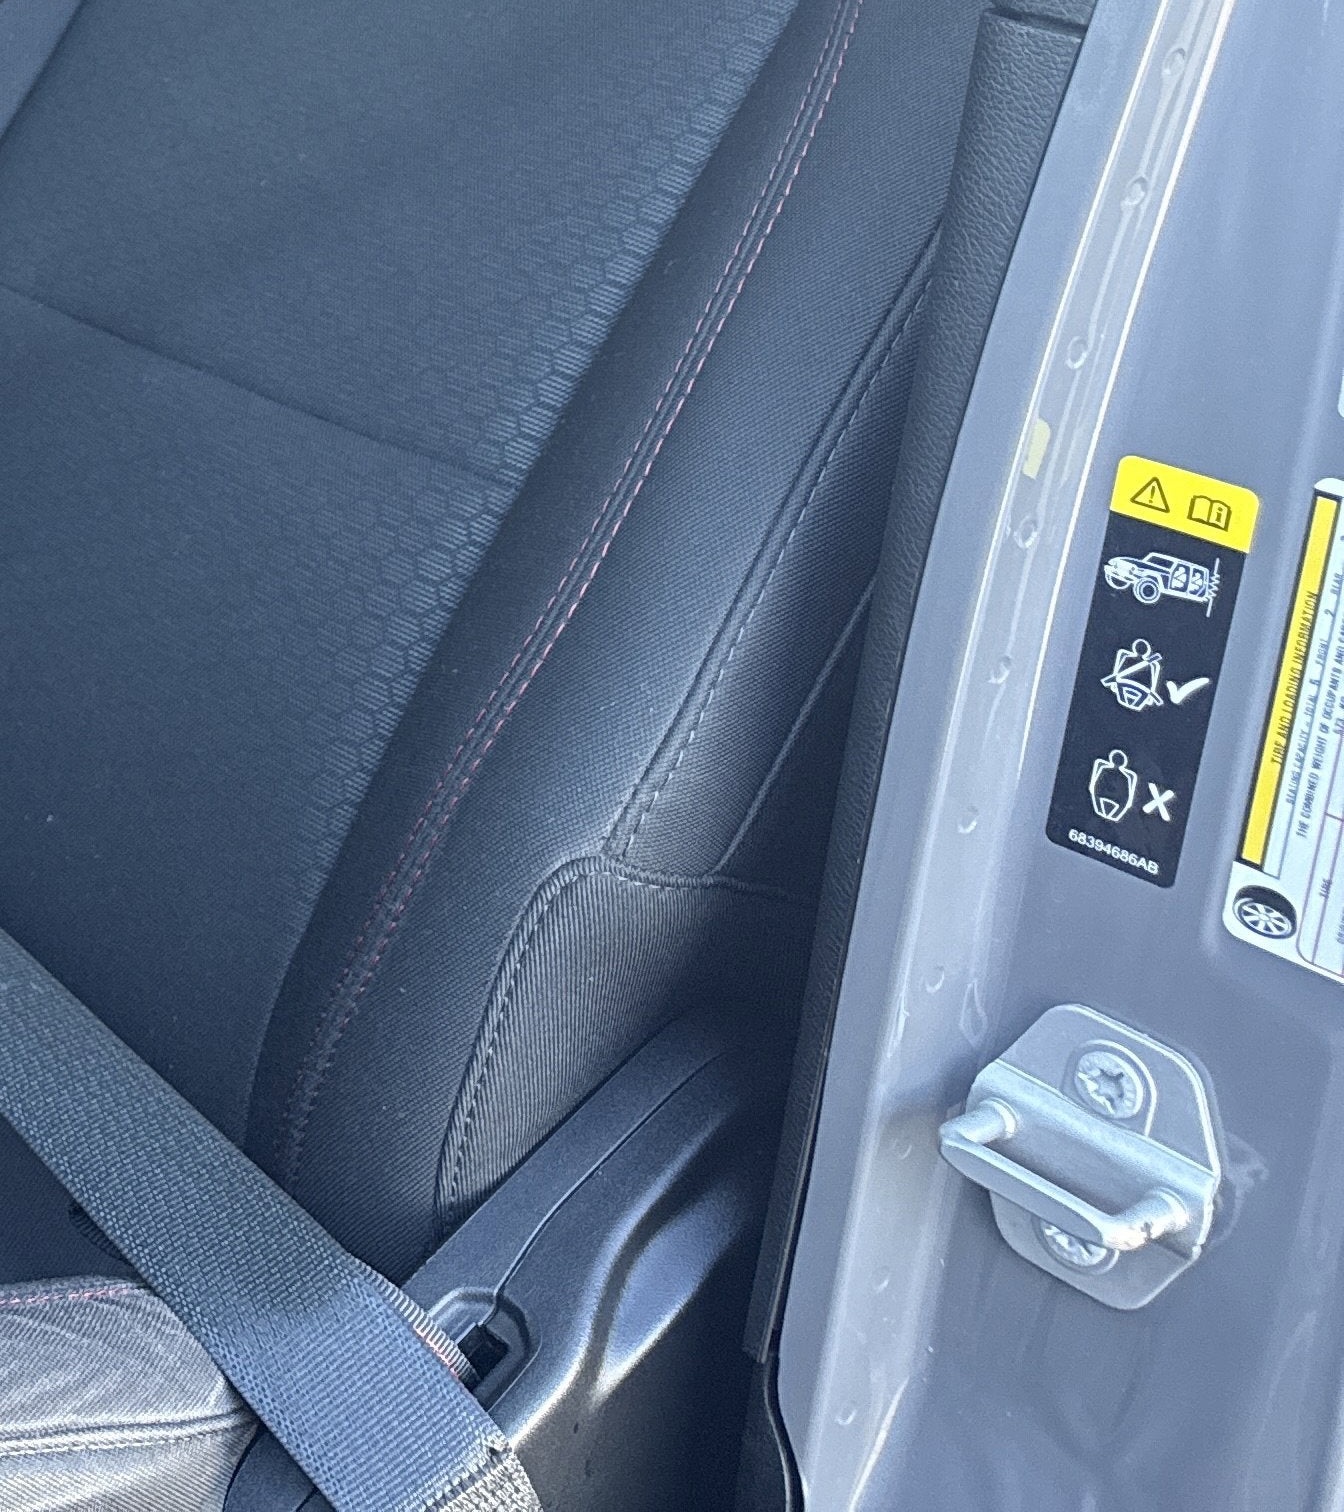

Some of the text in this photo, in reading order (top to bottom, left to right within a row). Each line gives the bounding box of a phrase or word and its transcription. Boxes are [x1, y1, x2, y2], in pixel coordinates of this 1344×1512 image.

[1270, 590, 1318, 765] TIRE AND LOADING INFORMATION
[1322, 667, 1342, 720] OCCUPANTS
[1068, 828, 1160, 875] 68394686AB
